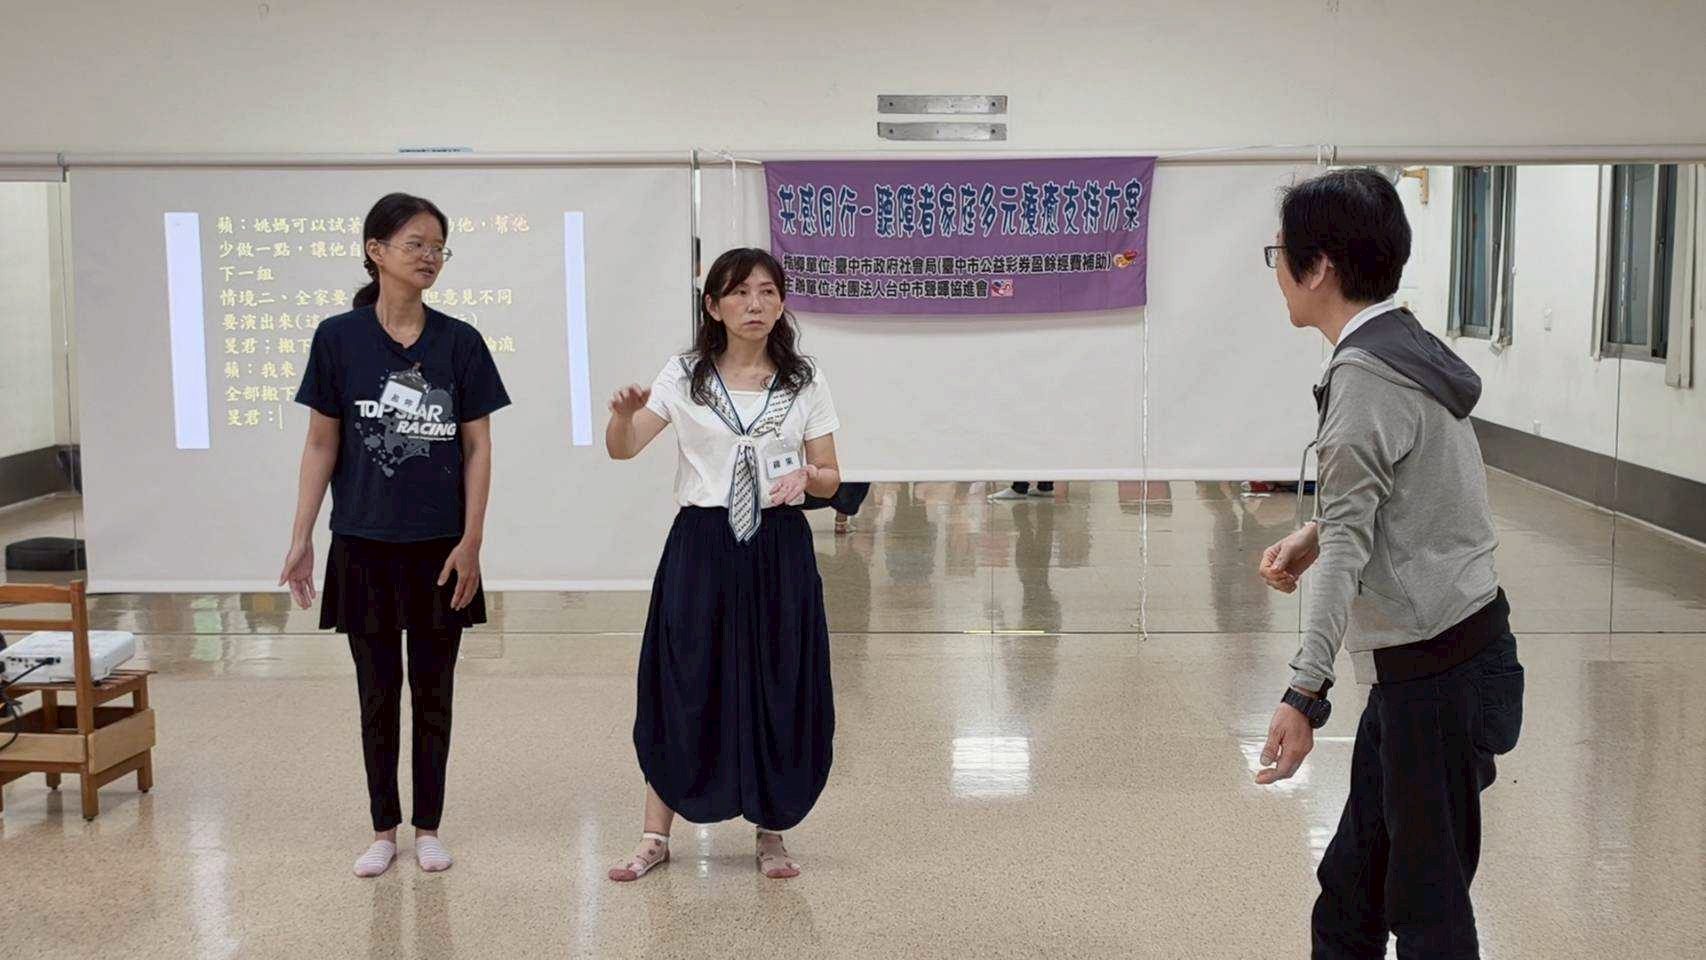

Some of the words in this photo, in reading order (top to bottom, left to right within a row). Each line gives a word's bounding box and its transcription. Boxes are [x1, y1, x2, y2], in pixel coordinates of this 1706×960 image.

[219, 265, 274, 282] 下一組
[219, 288, 356, 307] 情境二、全家要
[396, 420, 457, 436] RACING
